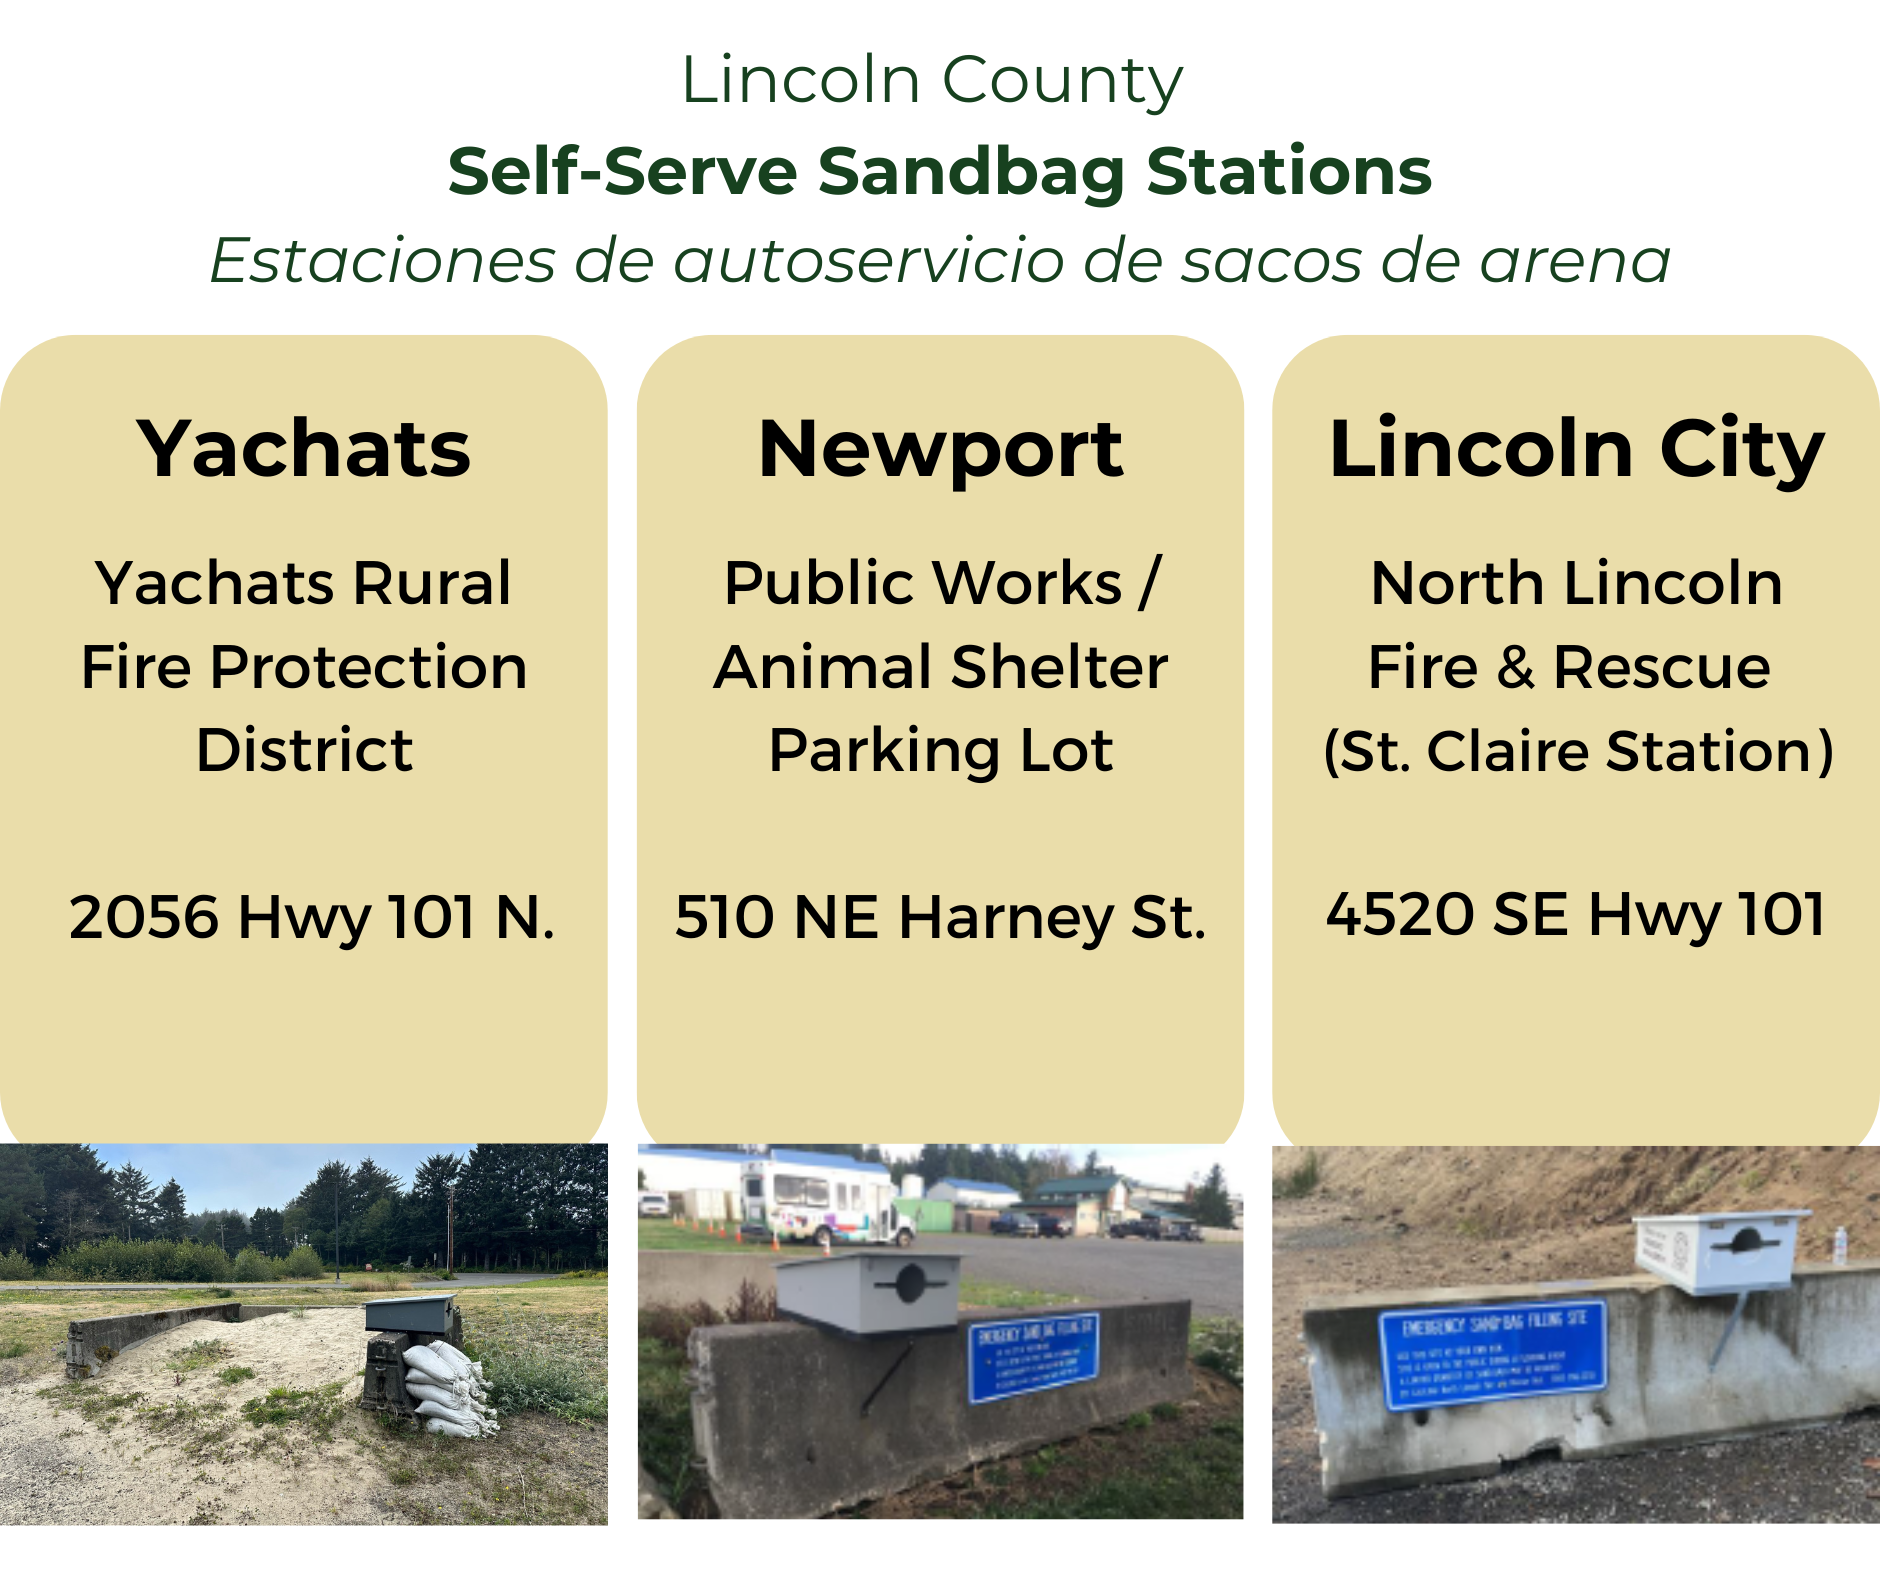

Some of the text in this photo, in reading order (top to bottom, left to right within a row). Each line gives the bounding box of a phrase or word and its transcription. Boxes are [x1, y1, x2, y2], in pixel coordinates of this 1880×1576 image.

[1402, 1317, 1466, 1337] EMERGENCY
[1528, 1311, 1563, 1328] FILLING
[1567, 1310, 1588, 1325] SITE
